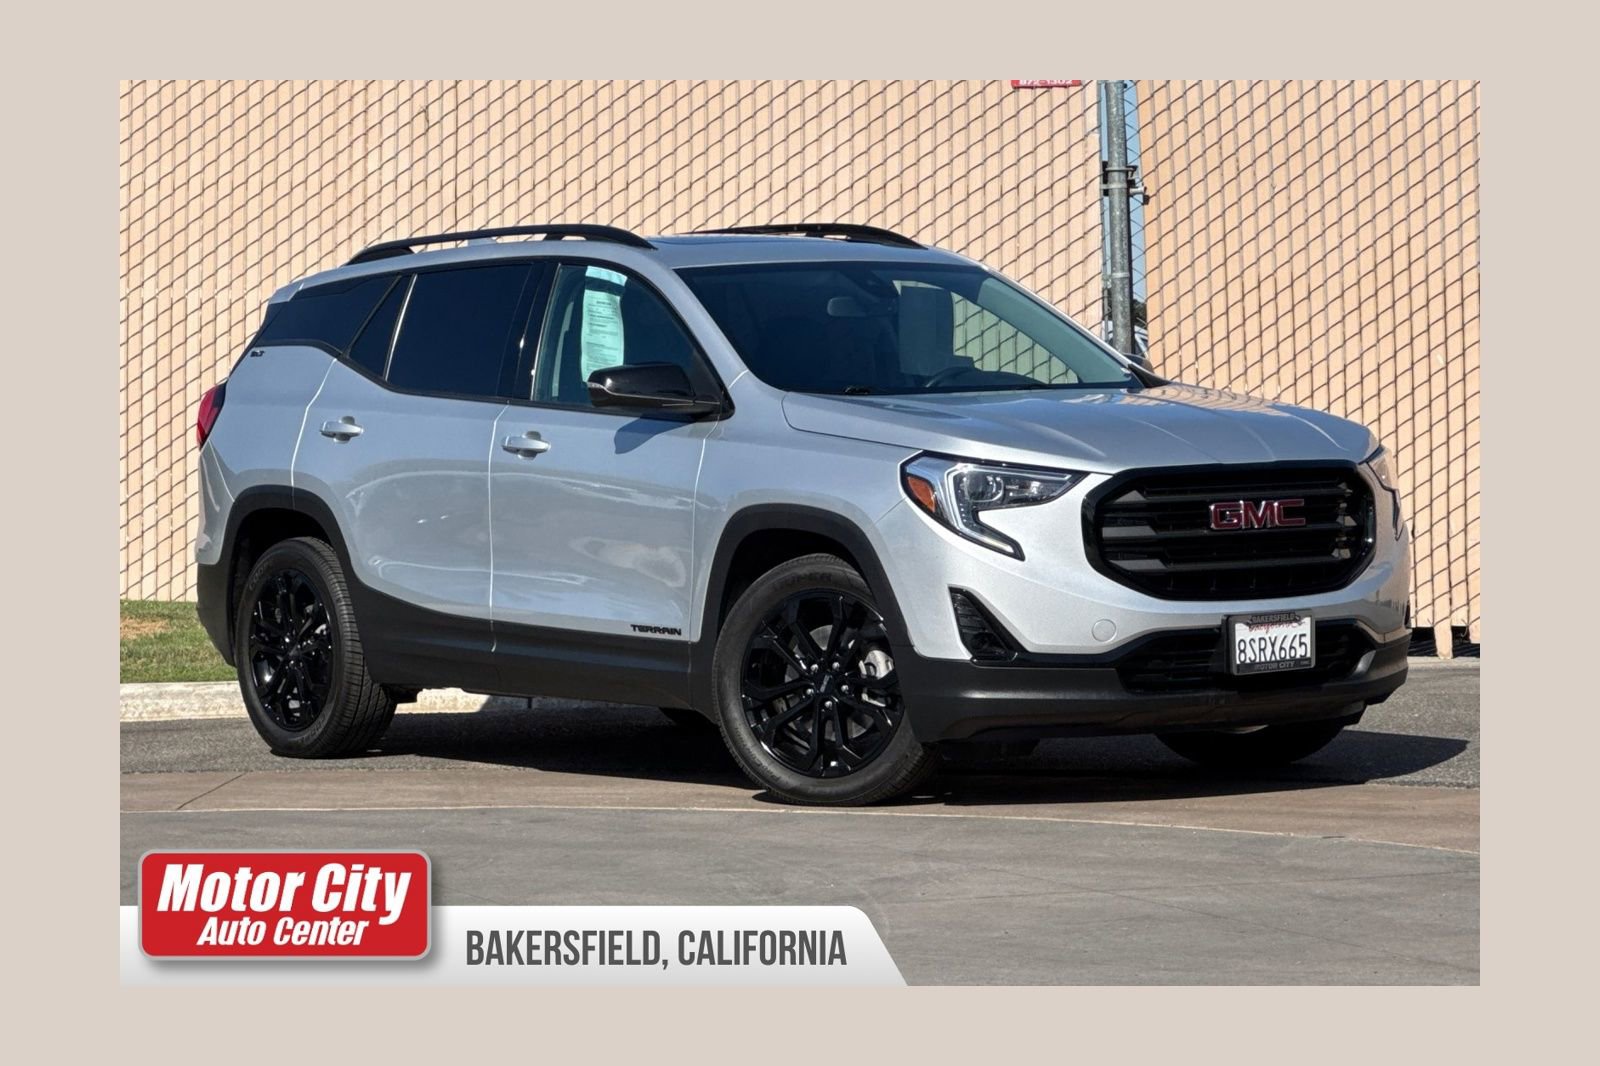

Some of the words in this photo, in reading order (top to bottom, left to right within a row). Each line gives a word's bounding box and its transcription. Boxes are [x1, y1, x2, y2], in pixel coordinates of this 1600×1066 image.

[1209, 499, 1306, 530] GMC
[1252, 613, 1295, 622] BAKERSFIELD
[630, 624, 682, 636] TERRAIN
[1237, 633, 1308, 664] 8SRX665
